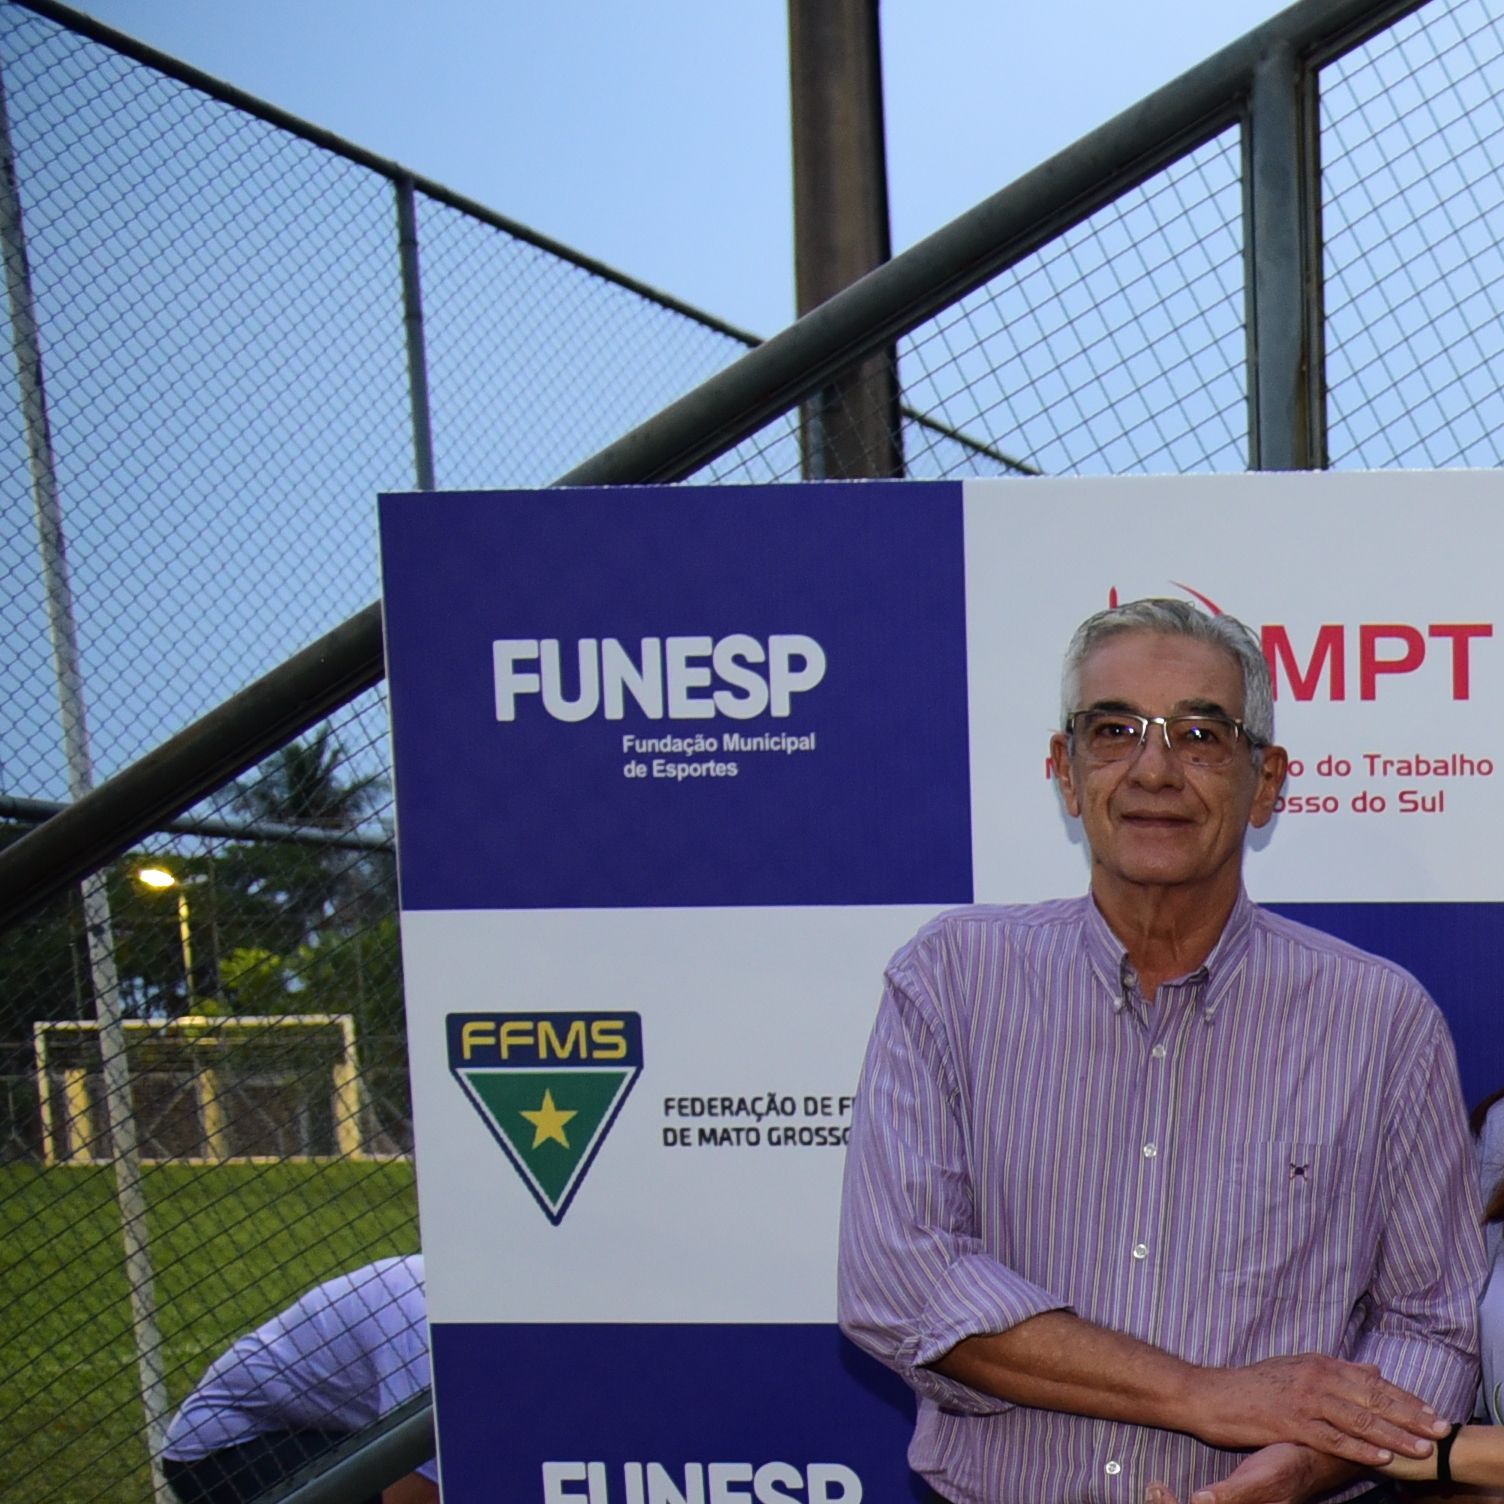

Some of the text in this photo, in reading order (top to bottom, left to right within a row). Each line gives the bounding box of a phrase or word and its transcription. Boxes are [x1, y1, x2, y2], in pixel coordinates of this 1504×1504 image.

[1261, 624, 1492, 701] MPT
[493, 634, 826, 722] FUNESP
[623, 733, 816, 755] Fundação Municipal
[624, 759, 738, 781] de Esportes
[1317, 754, 1351, 777] do
[1363, 754, 1493, 777] Trabalho
[1273, 791, 1444, 813] osso do Sul
[462, 1020, 627, 1059] FFMS
[664, 1092, 795, 1122] FEDERAÇÃO
[804, 1097, 832, 1116] DE
[663, 1127, 691, 1147] DE
[698, 1127, 760, 1146] MATO
